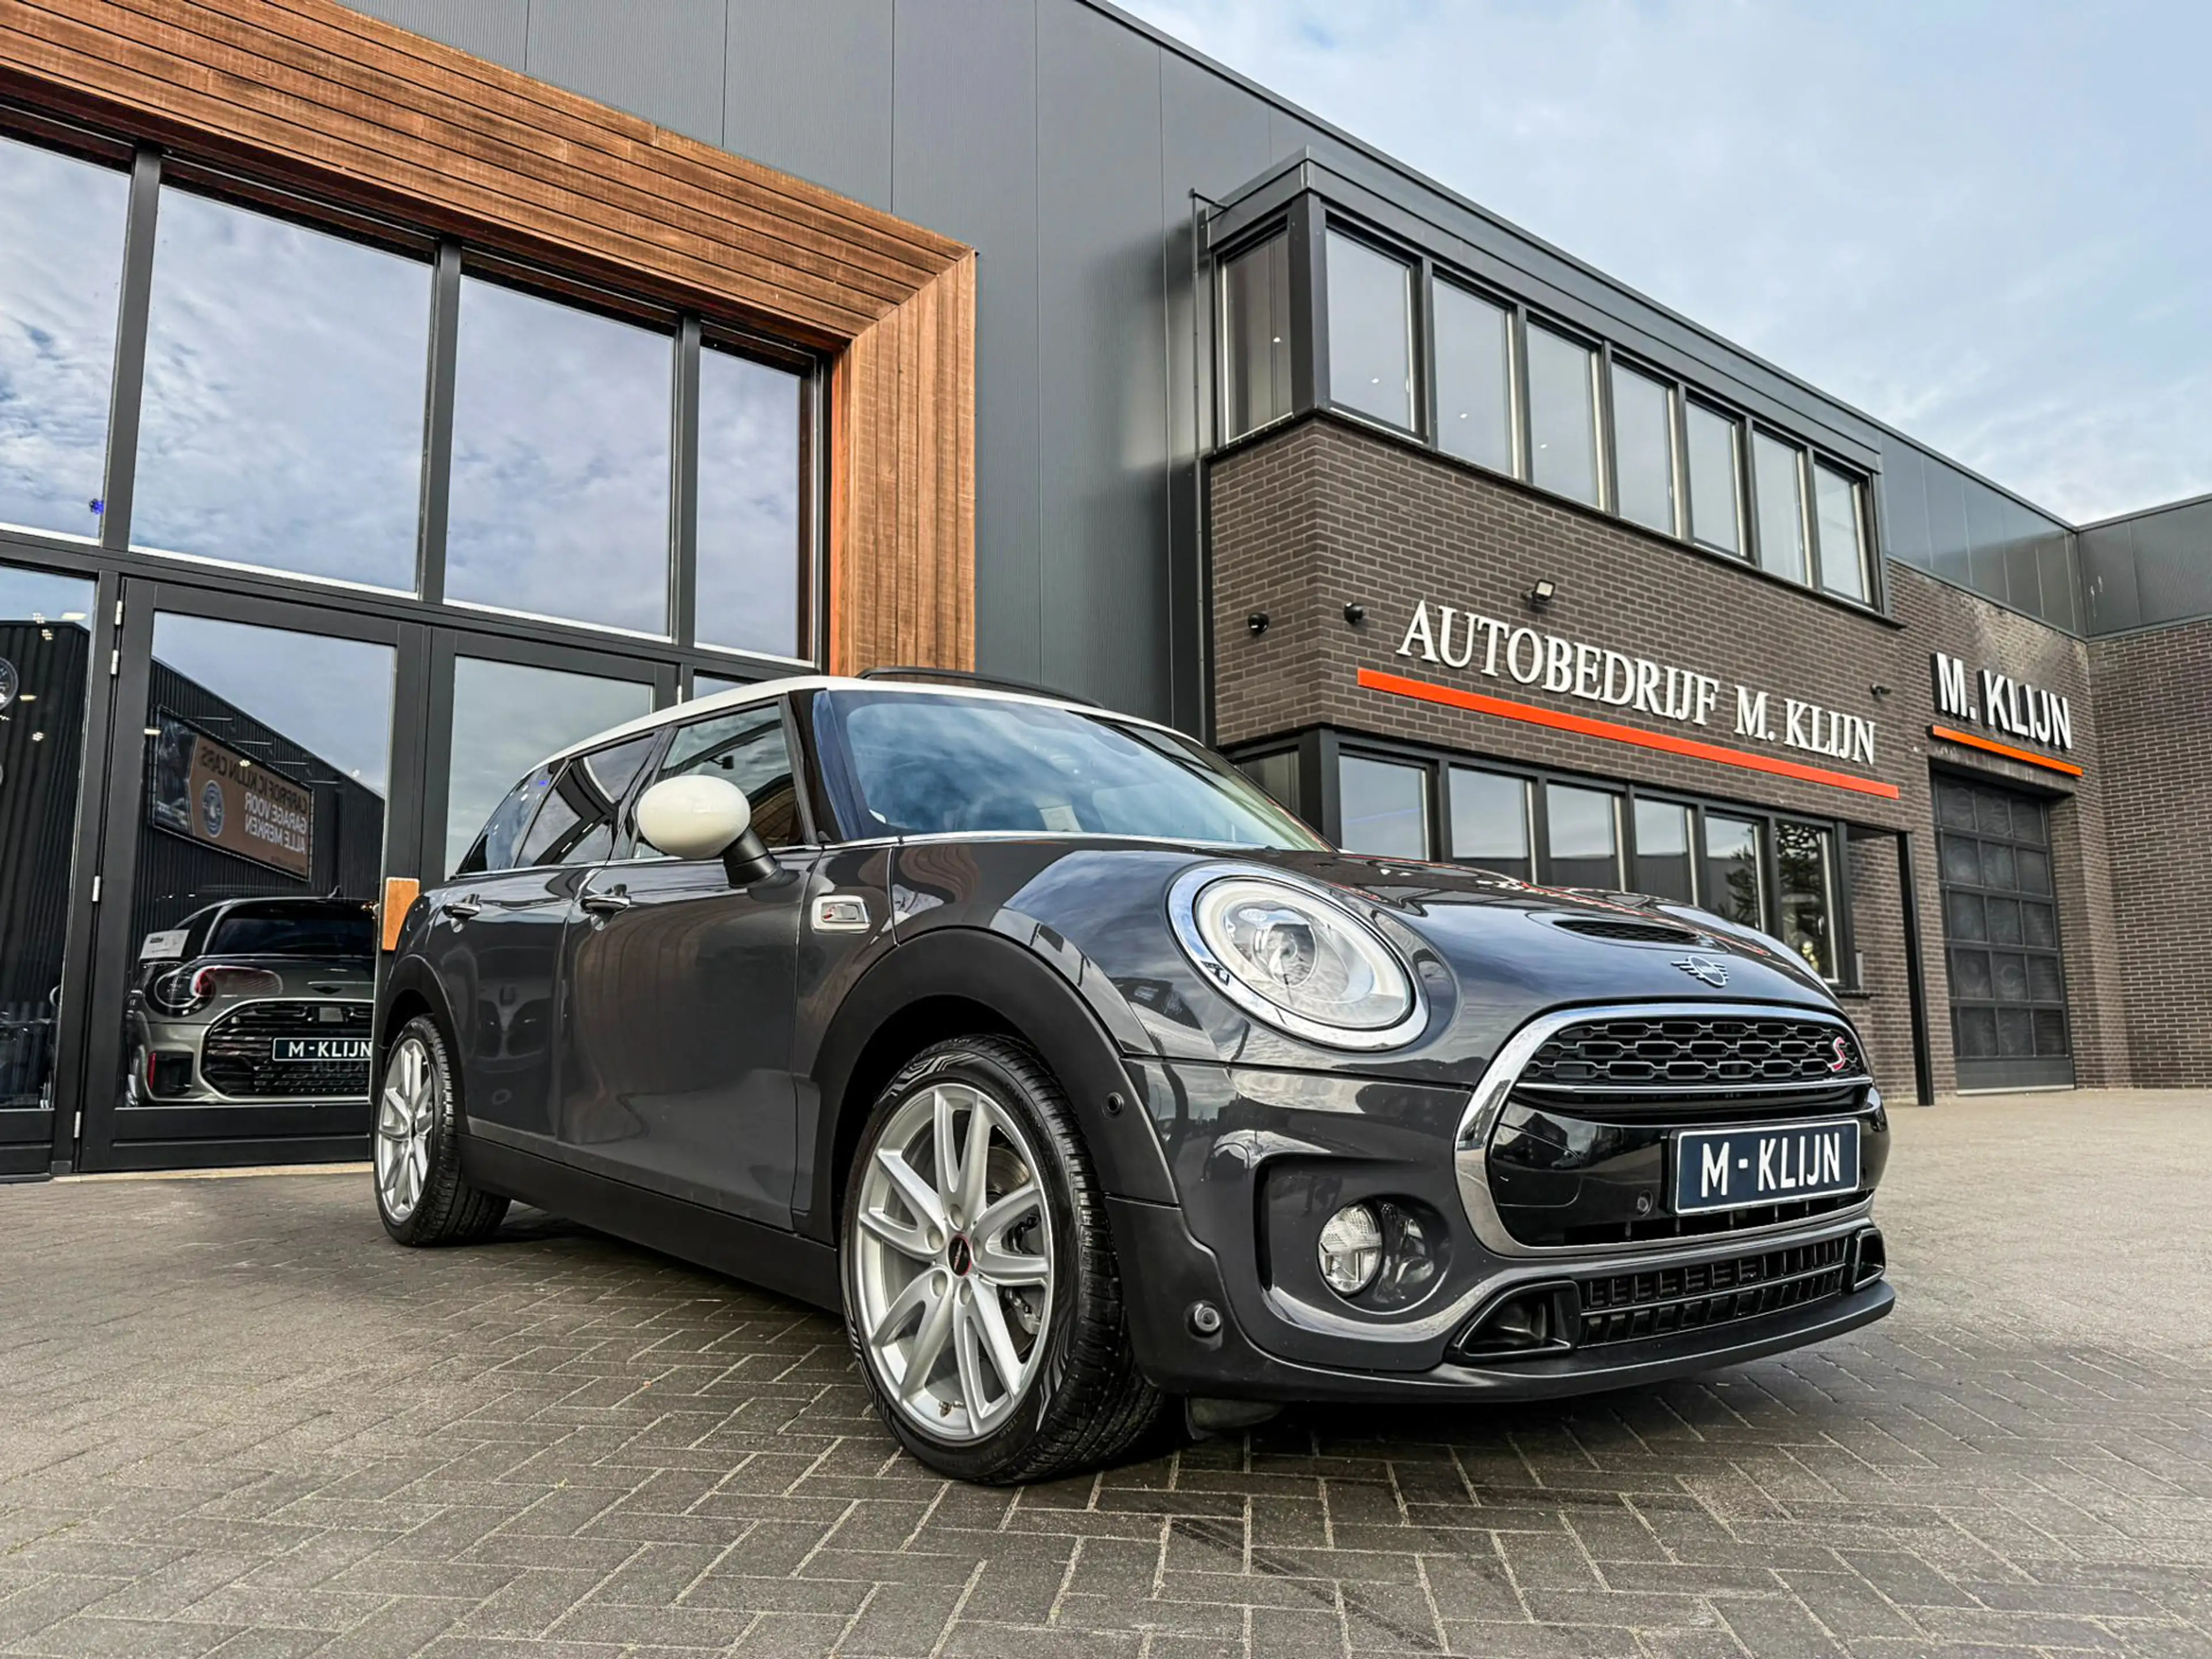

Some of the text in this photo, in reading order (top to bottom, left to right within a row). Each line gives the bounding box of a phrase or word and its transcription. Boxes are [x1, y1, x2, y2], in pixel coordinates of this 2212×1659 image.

[1396, 600, 1876, 766] AUTOBEDRIJF M. KLIJN
[1936, 652, 2072, 749] M. KLIJN
